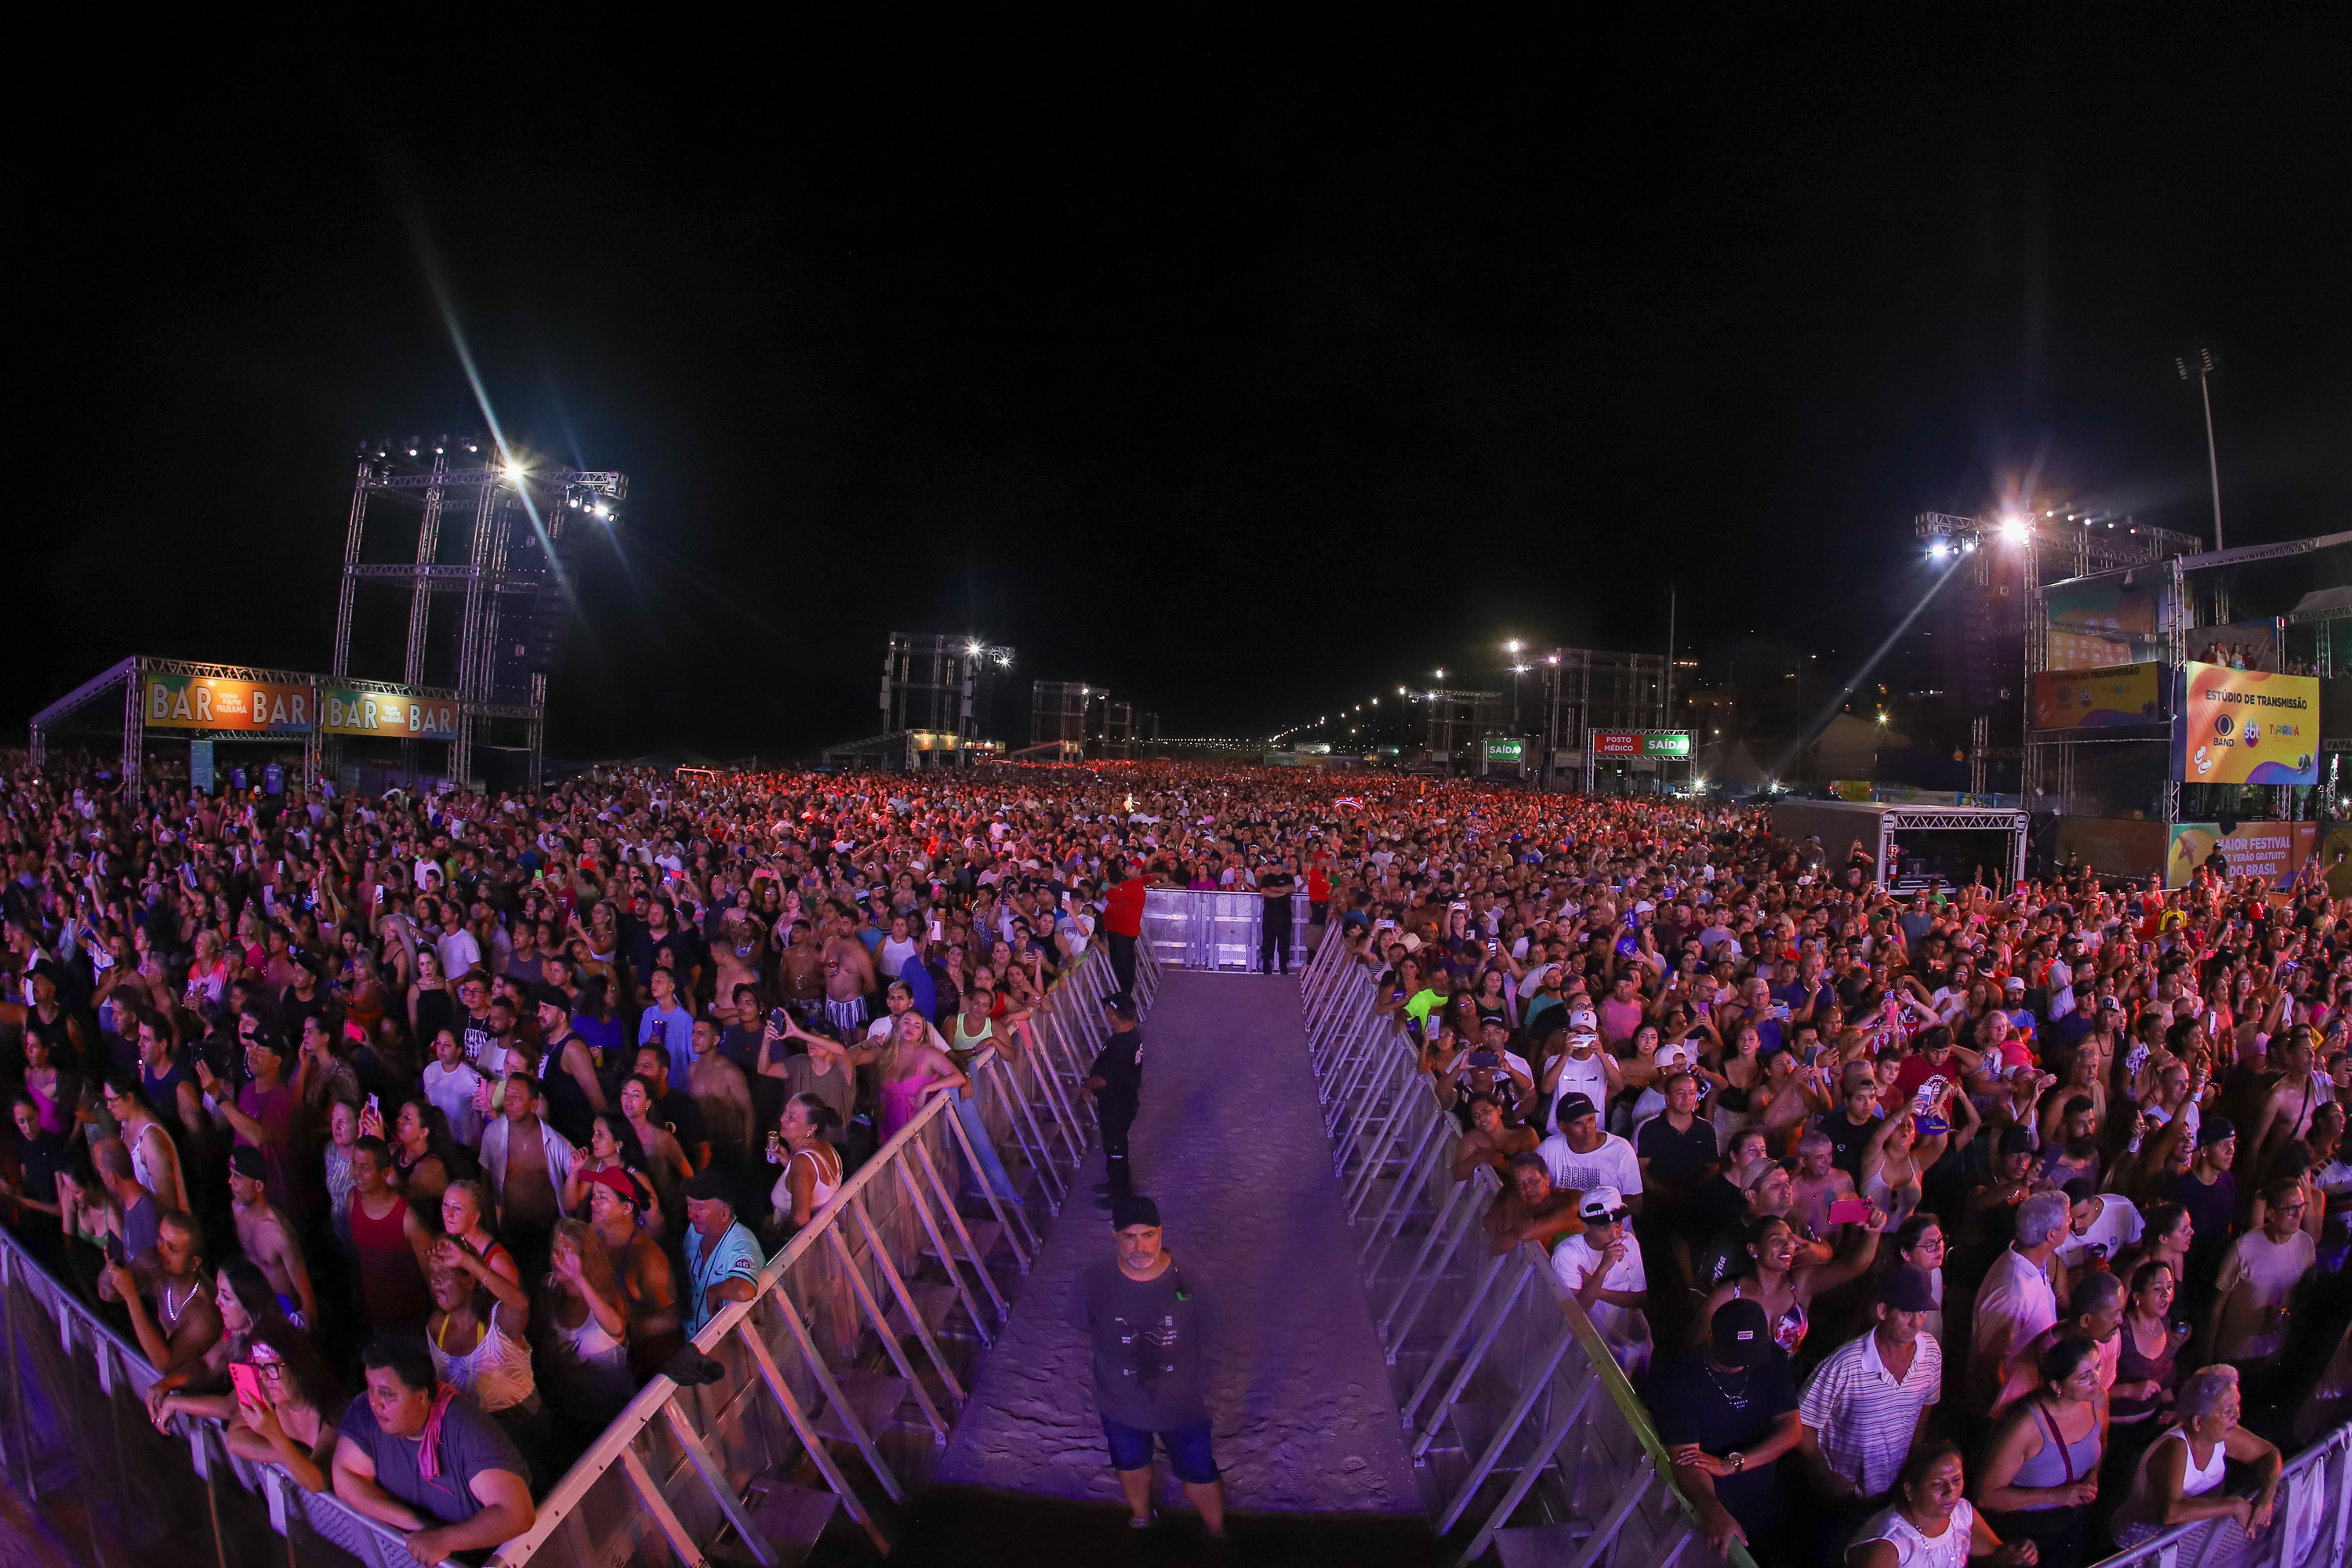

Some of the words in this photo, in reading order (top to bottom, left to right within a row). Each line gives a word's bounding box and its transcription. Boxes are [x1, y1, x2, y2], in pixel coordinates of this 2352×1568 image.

[153, 683, 214, 721] BAR
[252, 691, 307, 725] BAR
[2205, 689, 2242, 703] ESTÚDIO
[2245, 694, 2255, 705] DE
[2257, 695, 2307, 710] TRANSMISSÃO
[329, 696, 379, 729] BAR
[409, 704, 452, 734] BAR
[2245, 720, 2259, 739] sbt
[1490, 745, 1519, 754] SAÍDA
[2213, 738, 2234, 747] BAND
[2250, 837, 2291, 850] FESTIVAL
[2233, 851, 2254, 862] VERÃO
[2256, 851, 2285, 861] GRATUITO
[2230, 865, 2244, 877] DO
[2246, 862, 2277, 877] BRASIL
